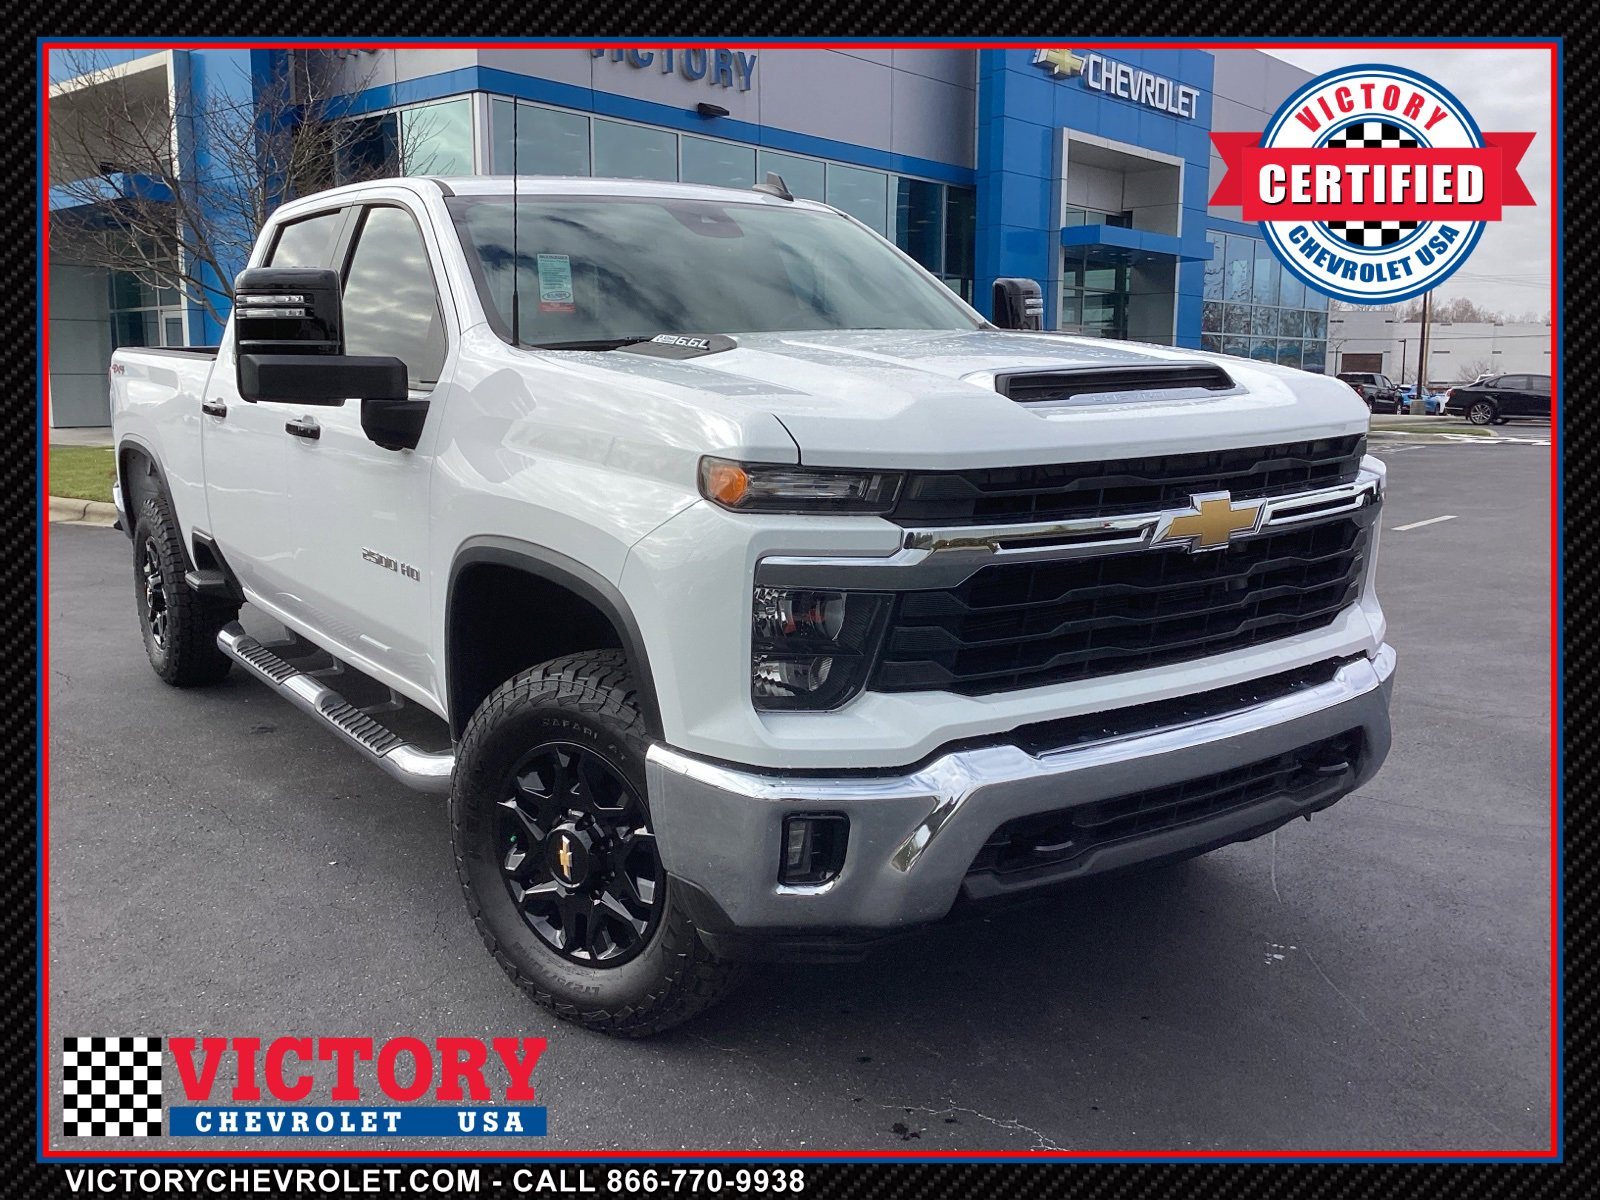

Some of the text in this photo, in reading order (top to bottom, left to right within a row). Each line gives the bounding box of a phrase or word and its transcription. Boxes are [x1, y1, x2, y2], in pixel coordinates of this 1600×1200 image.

[590, 48, 757, 91] CTORY
[1088, 53, 1200, 119] CHEVROLET
[400, 562, 421, 582] HD
